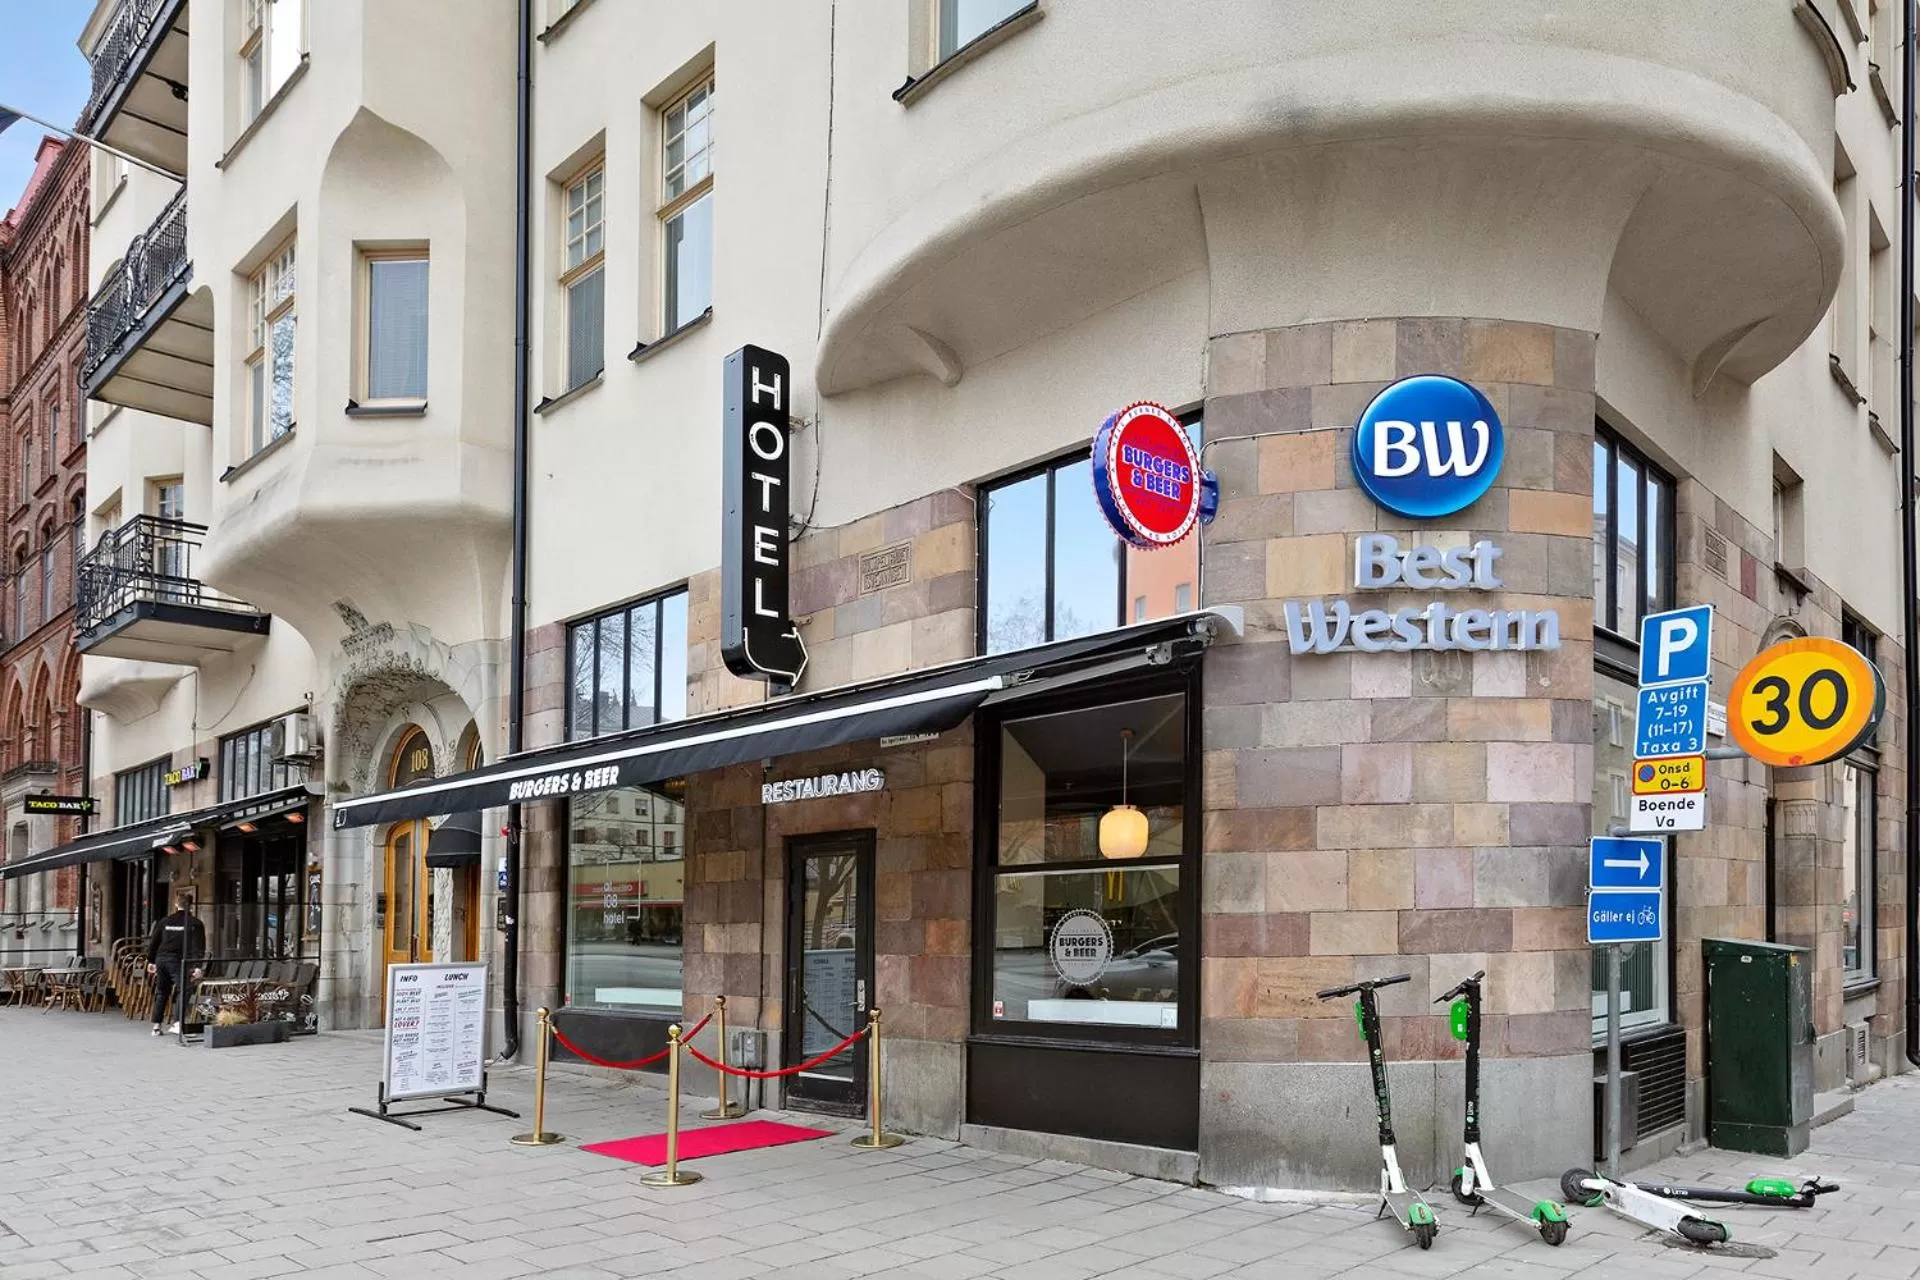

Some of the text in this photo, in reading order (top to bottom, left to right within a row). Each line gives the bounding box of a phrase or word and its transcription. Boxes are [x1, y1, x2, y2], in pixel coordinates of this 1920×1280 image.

[1373, 420, 1490, 477] BW
[1122, 444, 1190, 484] BURGERS
[748, 365, 784, 619] HOTEL
[1131, 469, 1181, 500] & BEER
[1354, 532, 1504, 589] Best
[1283, 599, 1561, 655] Western
[1658, 617, 1698, 677] P
[1648, 686, 1699, 705] Avgift
[1751, 668, 1849, 735] 30
[1655, 705, 1688, 720] 7-19
[1648, 719, 1693, 738] (11-17)
[1642, 738, 1698, 754] Taxa 3
[411, 748, 428, 773] 108
[1658, 762, 1690, 774] Onsd
[164, 766, 195, 786] TACO BAR
[508, 766, 619, 801] BURGERS & BEER
[1660, 778, 1689, 790] 0-6
[762, 768, 885, 804] RESTAURANG
[1639, 798, 1696, 811] Boende
[1655, 817, 1675, 828] Va
[604, 910, 624, 924] hotel
[1593, 909, 1635, 925] Gäller ej
[1059, 937, 1104, 947] BURGERS
[1065, 948, 1097, 957] & BEER
[444, 973, 469, 981] LUNCH
